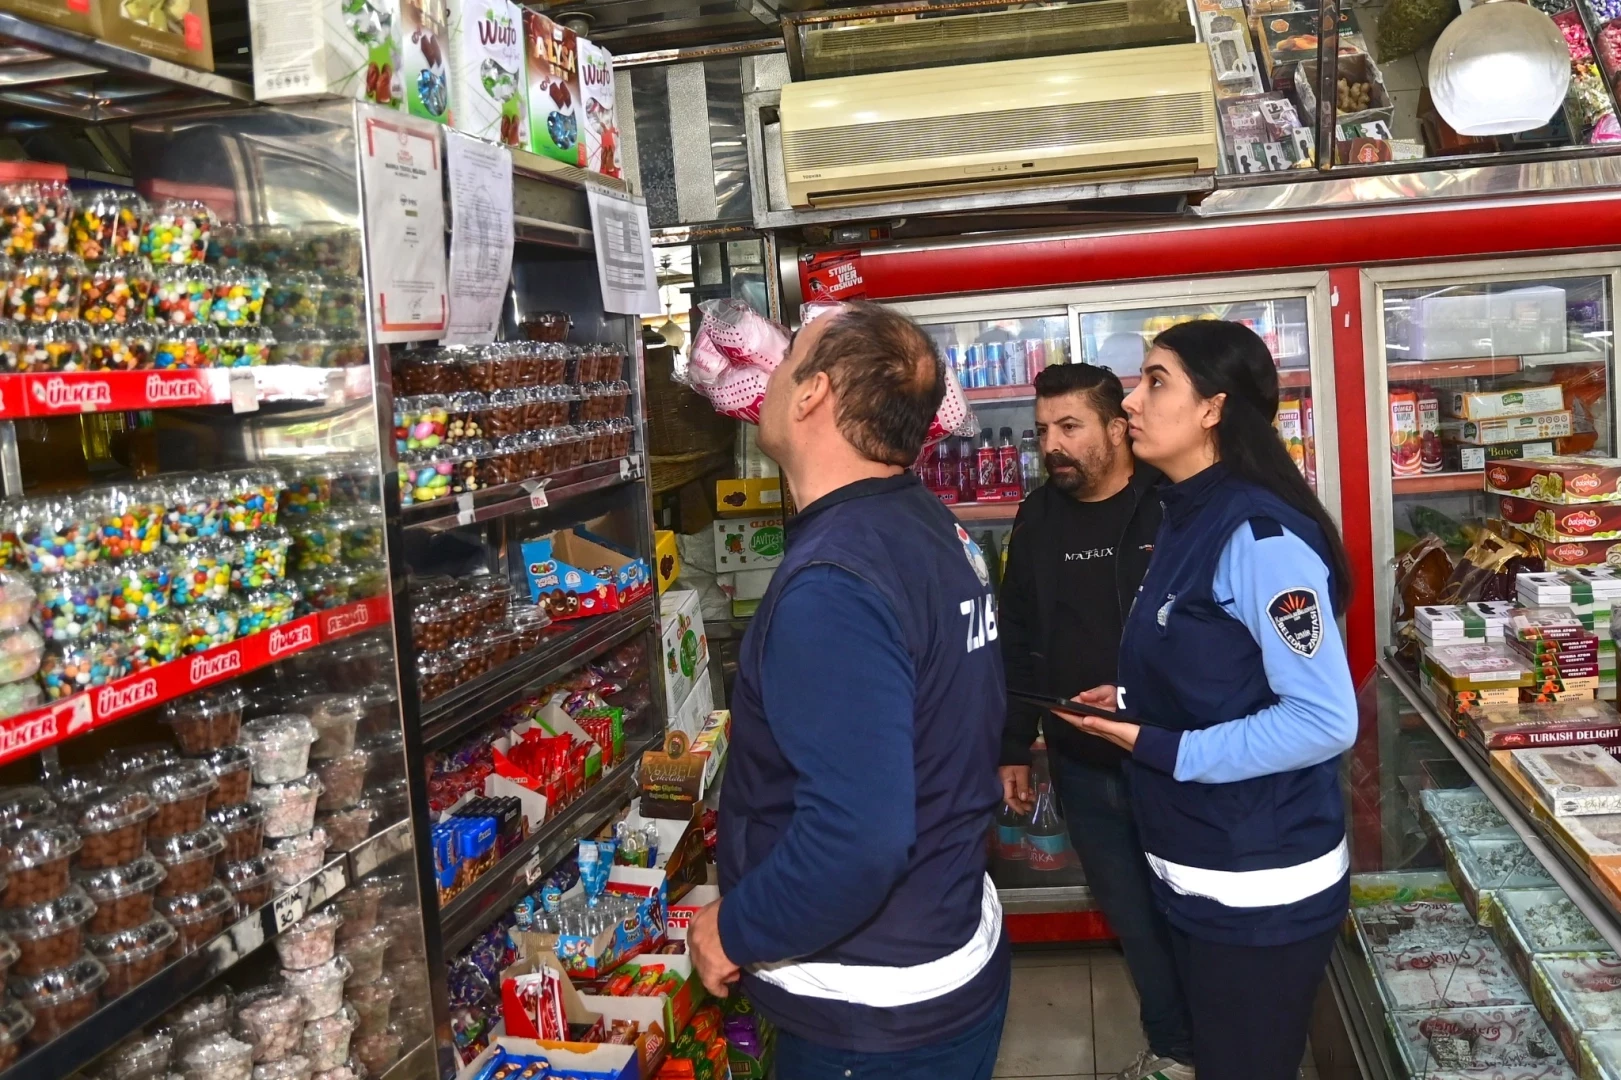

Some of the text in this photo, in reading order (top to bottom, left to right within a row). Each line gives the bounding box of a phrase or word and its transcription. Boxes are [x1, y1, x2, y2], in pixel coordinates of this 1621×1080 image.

[478, 18, 517, 47] Wufo
[534, 36, 576, 74] ALYSA
[582, 61, 611, 87] Wufo
[837, 270, 858, 283] VER
[47, 378, 109, 406] ÜLKER
[147, 374, 200, 400] ÜLKER
[1064, 546, 1115, 562] MATRIX
[190, 650, 241, 684] ÜLKER
[98, 679, 157, 717] ÜLKER
[0, 715, 57, 753] LKER
[1529, 731, 1573, 743] TURKISH
[1576, 728, 1620, 740] DELIGHT
[667, 911, 693, 919] LKER
